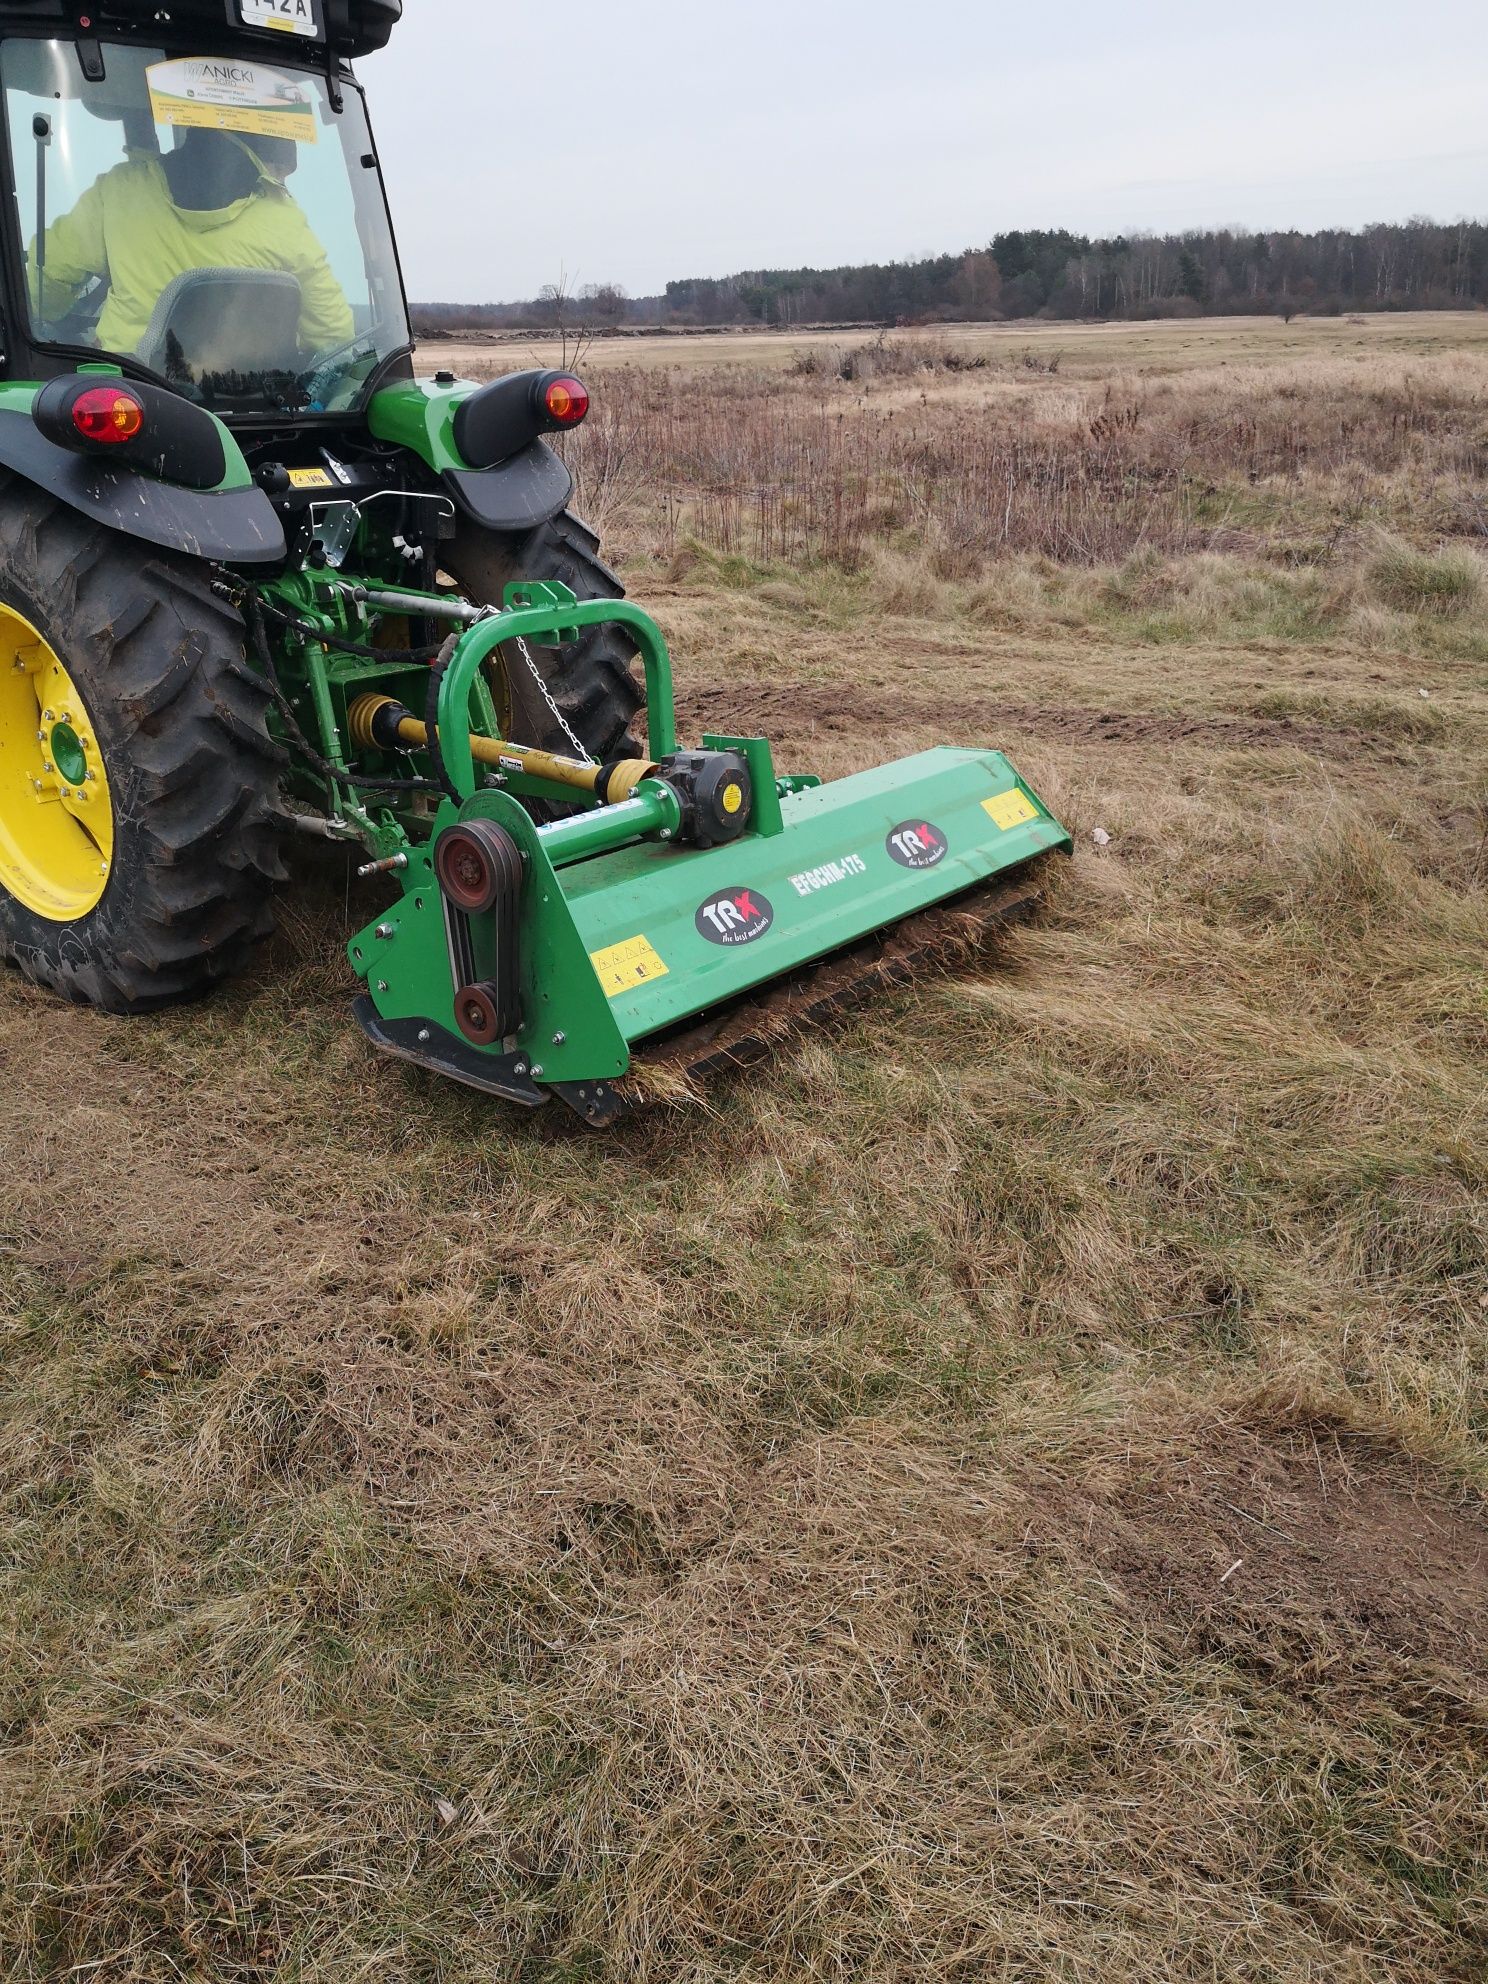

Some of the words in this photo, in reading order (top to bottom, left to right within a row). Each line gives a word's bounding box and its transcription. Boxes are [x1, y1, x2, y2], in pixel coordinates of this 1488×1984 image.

[891, 824, 939, 858] TRX
[703, 891, 761, 934] TRX
[734, 931, 748, 942] best
